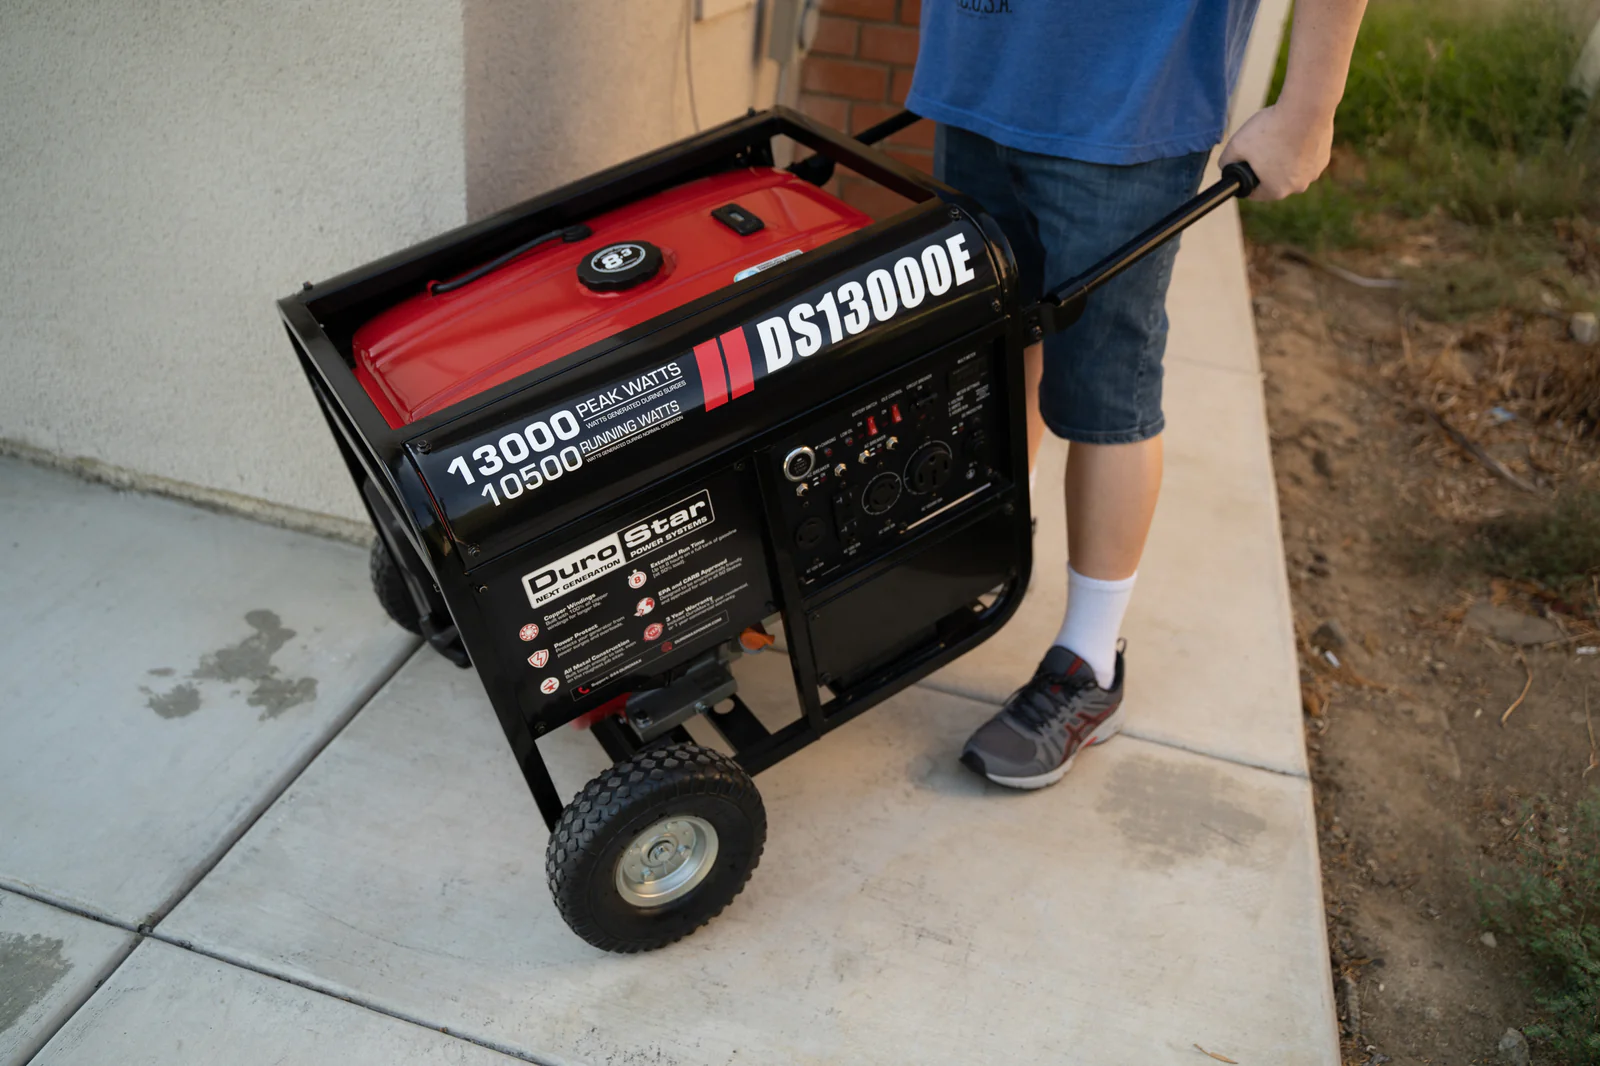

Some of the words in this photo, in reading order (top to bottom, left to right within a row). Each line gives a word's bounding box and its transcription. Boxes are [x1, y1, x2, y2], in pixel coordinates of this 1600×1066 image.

[756, 232, 975, 374] DS13000E
[586, 415, 608, 430] WATTS
[606, 400, 641, 421] GENERATED
[640, 391, 663, 407] DURING
[662, 380, 686, 396] SURGES
[447, 410, 580, 485] 13000
[575, 388, 624, 418] PEAK
[621, 362, 682, 396] WATTS
[586, 452, 602, 463] WATTS
[601, 440, 626, 455] GENERATED
[626, 432, 643, 445] DURING
[642, 425, 661, 439] NORMAL
[660, 415, 683, 431] OPERATION
[481, 446, 583, 507] 10500
[579, 418, 637, 453] RUNNING
[638, 400, 680, 426] WATTS
[528, 545, 618, 595] Duro
[623, 501, 706, 549] Star
[535, 589, 560, 604] NEXT
[562, 558, 621, 591] GENERATION
[630, 538, 664, 558] POWER
[665, 516, 708, 543] SYSTEMS
[650, 552, 678, 568] Extended
[678, 547, 690, 555] Run
[690, 539, 705, 548] Time
[670, 555, 684, 564] hours
[719, 529, 737, 541] gasoline
[658, 587, 671, 596] EPA
[672, 581, 682, 590] and
[683, 572, 700, 584] CARB
[701, 558, 728, 575] Approved
[670, 587, 691, 600] approved
[544, 608, 566, 621] Copper
[567, 594, 596, 609] Windings
[577, 606, 592, 615] longer
[590, 593, 608, 603] copper
[671, 610, 684, 619] Year
[685, 596, 713, 612] Warranty
[554, 636, 573, 648] Power
[574, 624, 598, 638] Protect
[589, 622, 612, 637] generator
[613, 616, 625, 624] from
[573, 658, 591, 670] Metal
[591, 639, 630, 661] Construction
